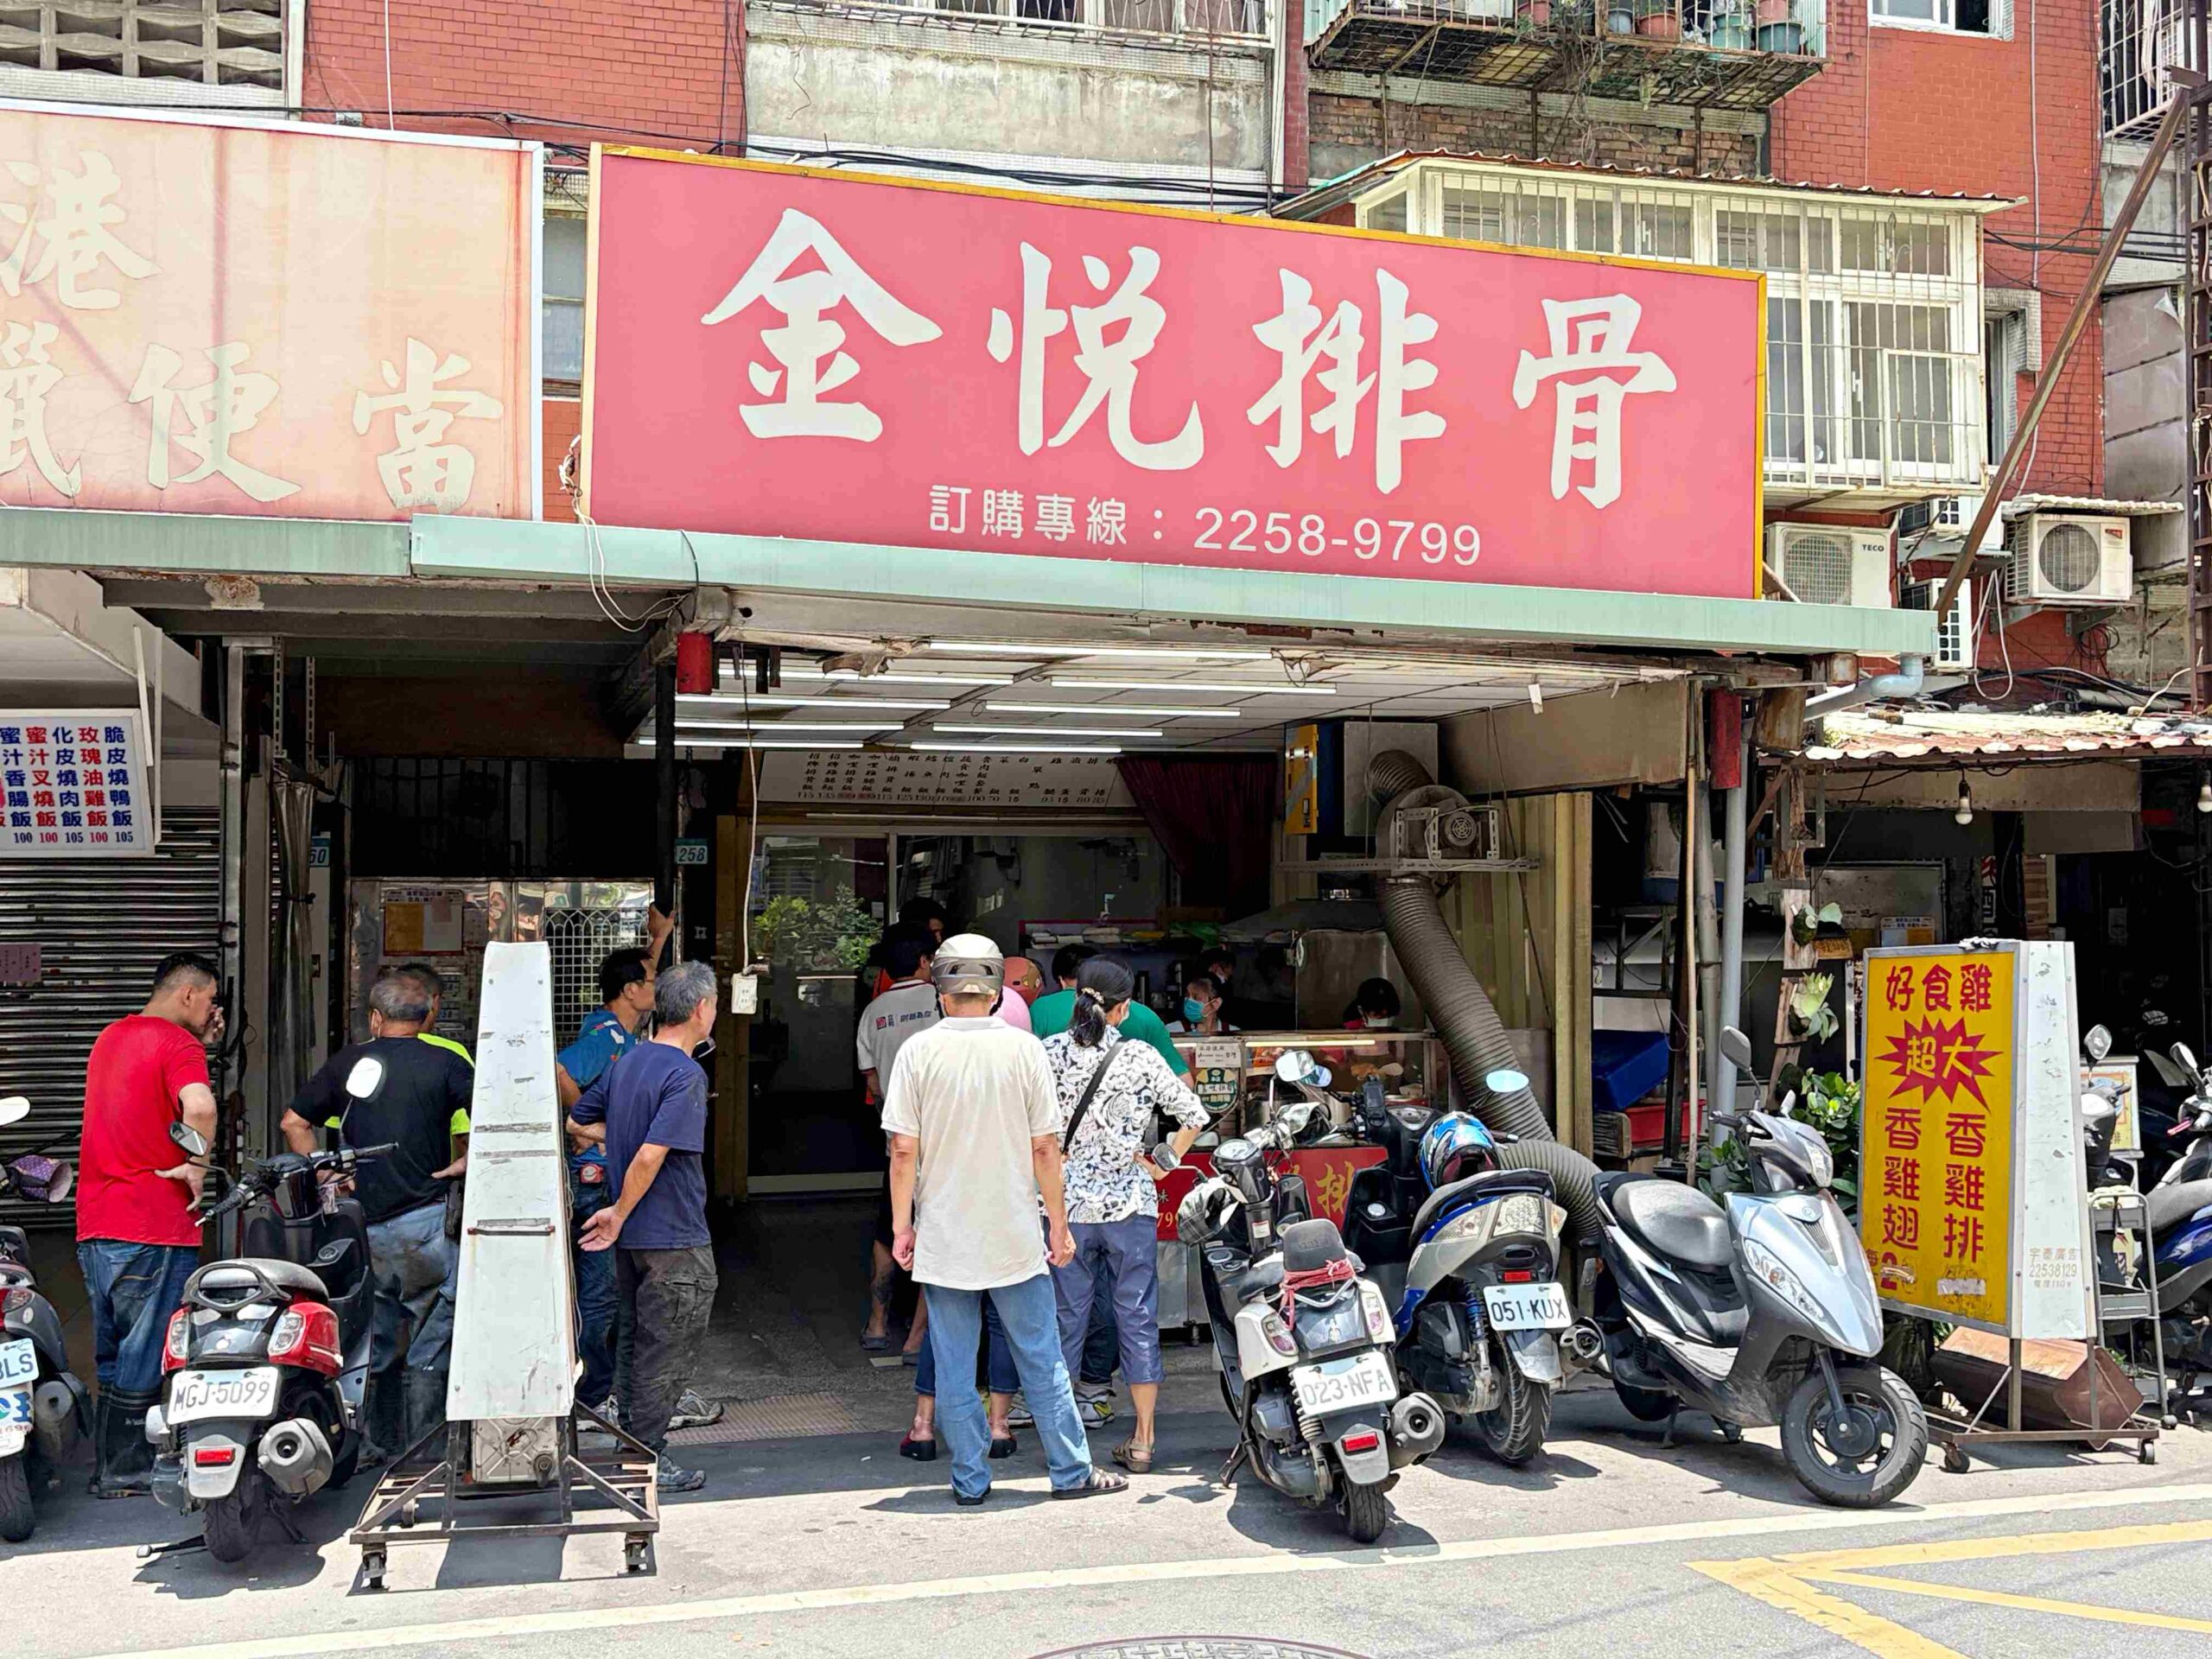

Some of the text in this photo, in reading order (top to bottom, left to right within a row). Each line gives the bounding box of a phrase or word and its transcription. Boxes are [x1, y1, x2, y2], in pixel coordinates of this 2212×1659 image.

[701, 207, 1676, 508] 金悅排骨
[1194, 507, 1480, 565] 2258-9799
[0, 727, 33, 843] 蜜汁香腸飯 100
[26, 727, 58, 843] 蜜汁叉燒飯 100
[53, 727, 84, 843] 化皮燒肉飯 105
[78, 727, 108, 843] 玫瑰油雞飯 100
[105, 727, 133, 842] 脆皮燒鴨飯 105
[678, 848, 706, 862] 258
[1886, 963, 1993, 1013] 好食雞
[1905, 1037, 1974, 1079] 超大
[1883, 1108, 1922, 1251] 香雞翅
[1943, 1113, 1986, 1264] 香雞排
[2029, 1263, 2077, 1278] 22538129
[0, 1353, 34, 1380] LS
